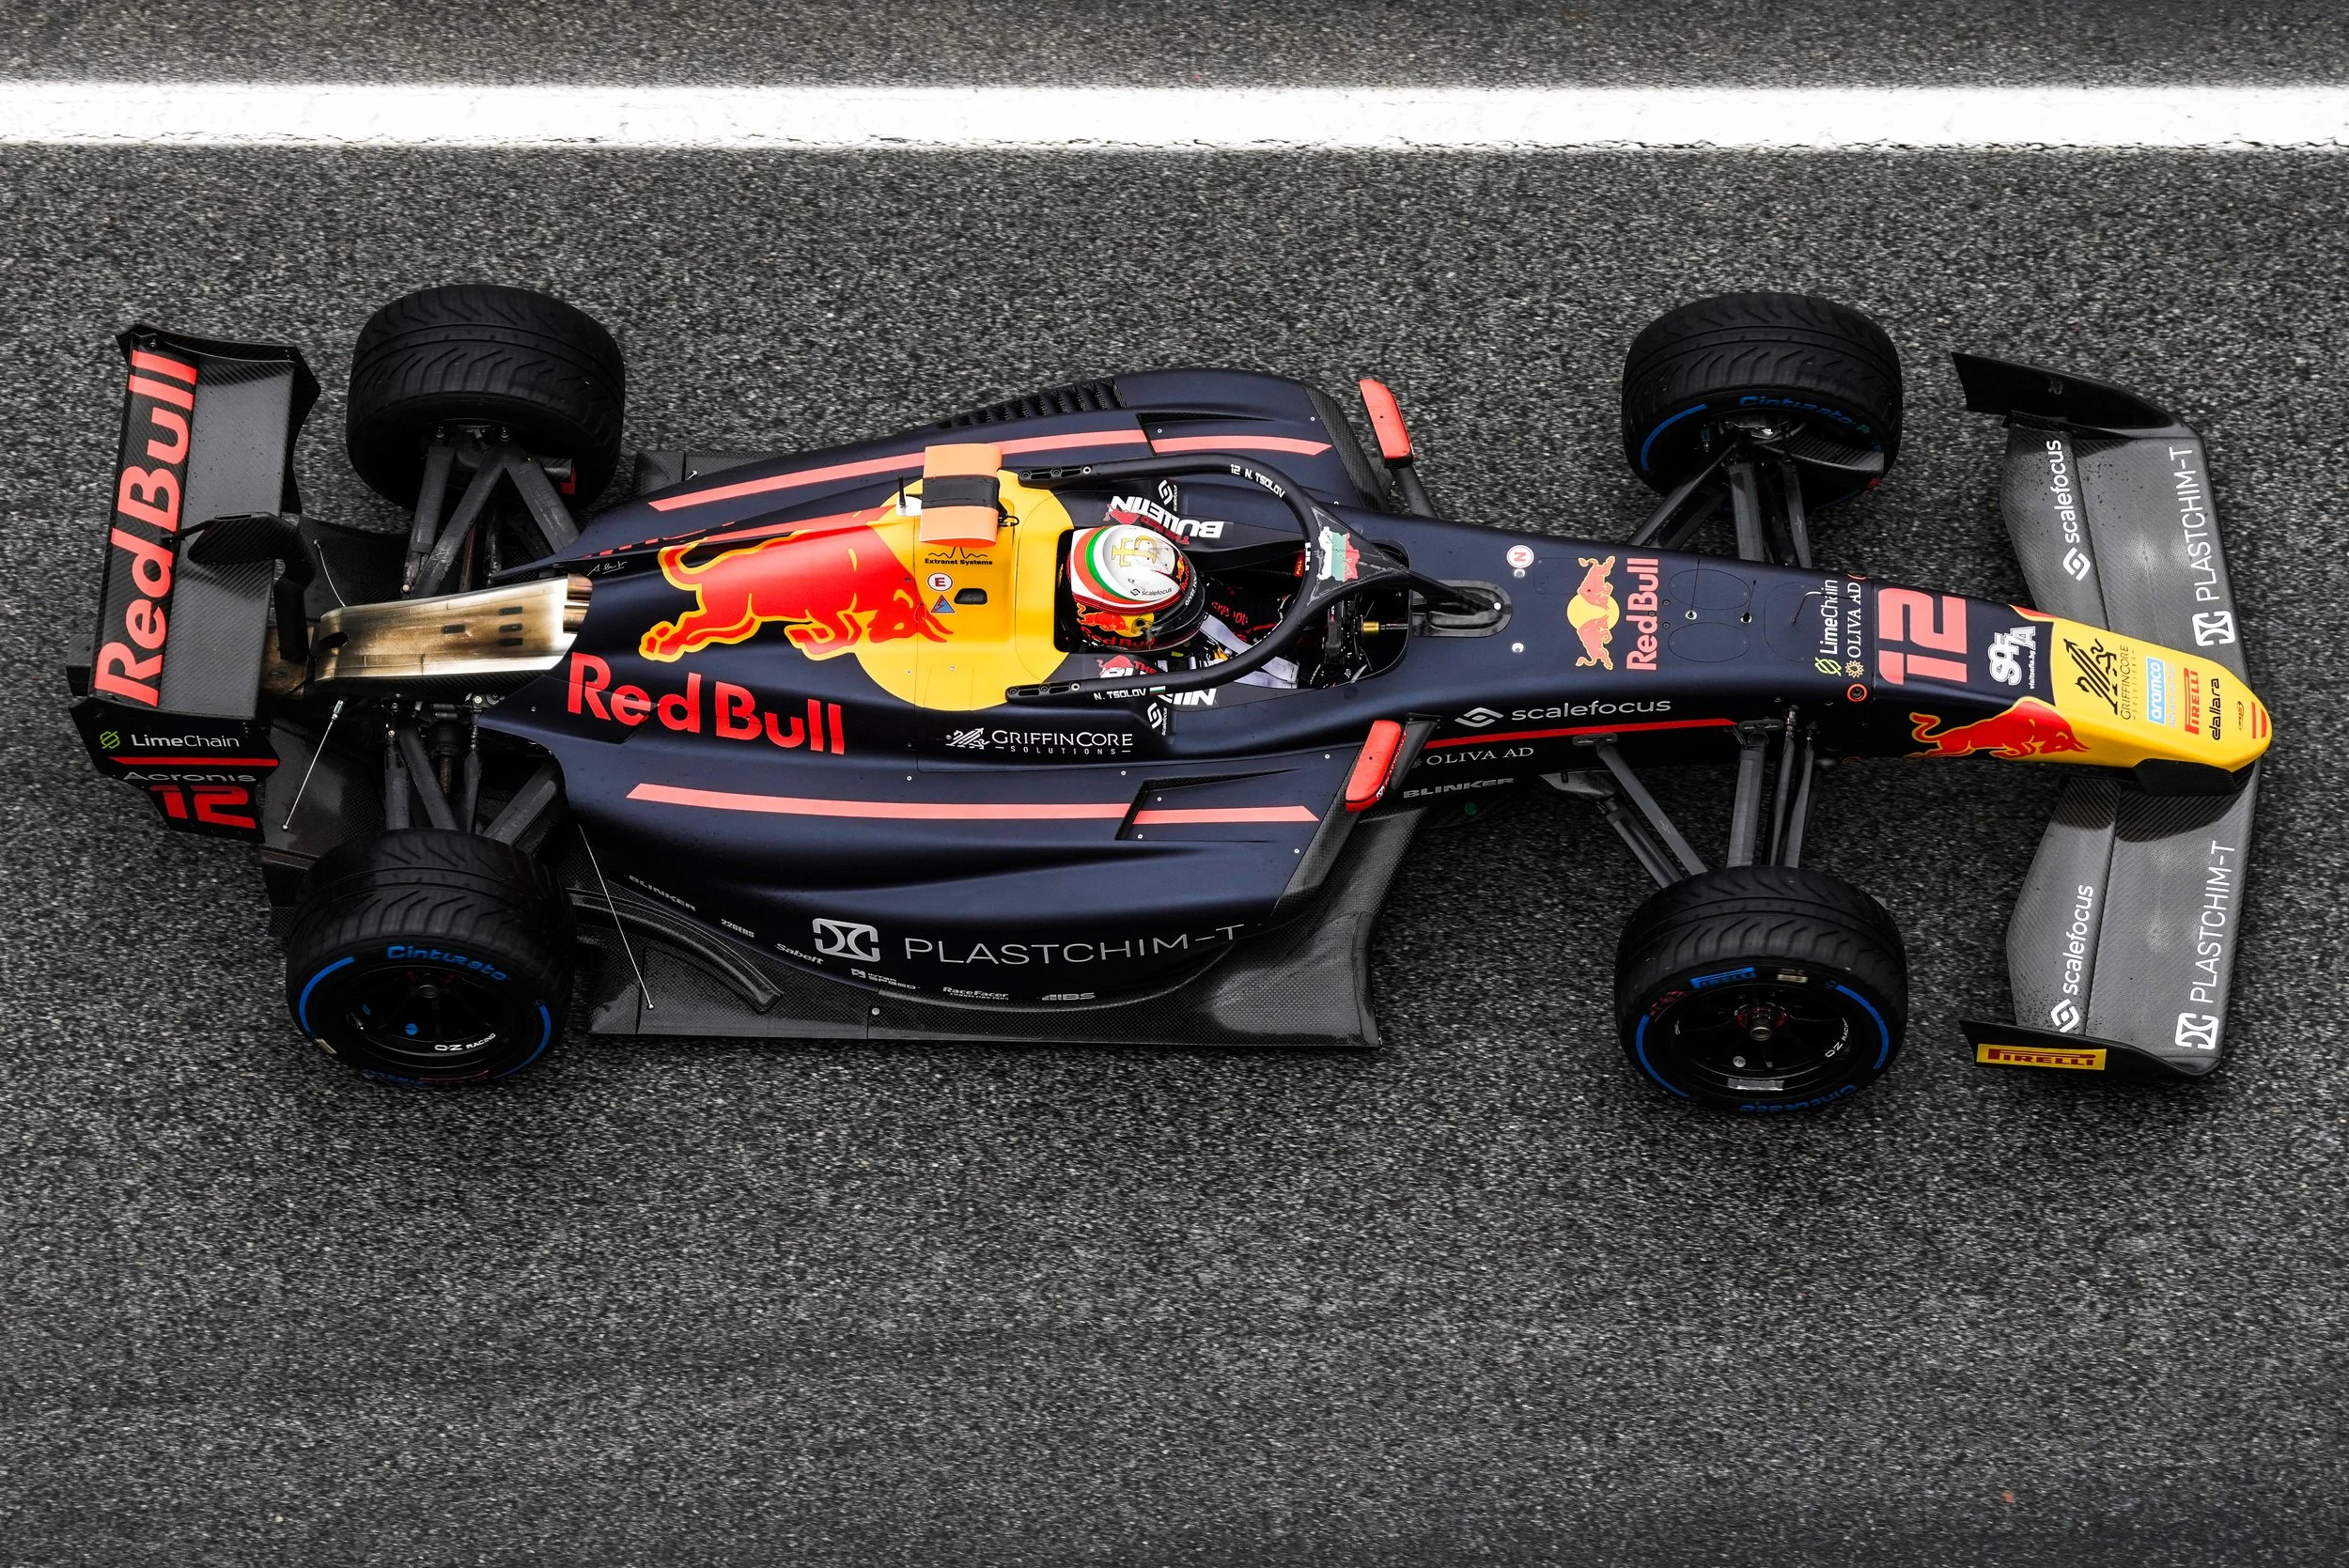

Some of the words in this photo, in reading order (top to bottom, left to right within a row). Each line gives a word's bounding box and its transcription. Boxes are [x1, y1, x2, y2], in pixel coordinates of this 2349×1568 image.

[1255, 472, 1286, 498] TSOLOV
[2046, 440, 2080, 544] scalefocus
[1109, 496, 1224, 538] BULLETIN
[2170, 446, 2220, 602] PLASTCHIM-T
[935, 577, 946, 587] E
[1141, 587, 1173, 596] scalefocus
[1847, 582, 1861, 605] AD
[1820, 579, 1838, 655] LimeChain
[1847, 608, 1861, 659] OLIVA
[1878, 587, 1968, 685] 12
[568, 651, 702, 734] Red
[715, 680, 845, 754] Bull
[1106, 688, 1146, 700] TSOLOV
[2150, 661, 2162, 720] aramco
[2184, 668, 2200, 735] PIRELLI
[2209, 678, 2221, 740] dallara
[1511, 700, 1672, 722] scalefocus
[131, 734, 241, 748] LimeChain
[1010, 746, 1116, 754] SOLUTIONS
[1426, 750, 1498, 767] OLIVA
[1502, 747, 1534, 759] AD
[123, 771, 257, 784] Acronis
[1403, 777, 1515, 799] BLINKER
[149, 784, 257, 830] 12
[629, 875, 696, 912] BLINKER
[2062, 884, 2094, 996] scalefocus
[2190, 840, 2235, 1003] PLASTCHIM-T
[775, 942, 824, 965] Sabelt
[905, 924, 1245, 965] PLASTCHIM-T
[386, 945, 509, 982] Cinturato
[942, 986, 1009, 998] RaceFacer
[465, 1032, 496, 1049] RACING
[1988, 1048, 2096, 1066] PIRELLI
